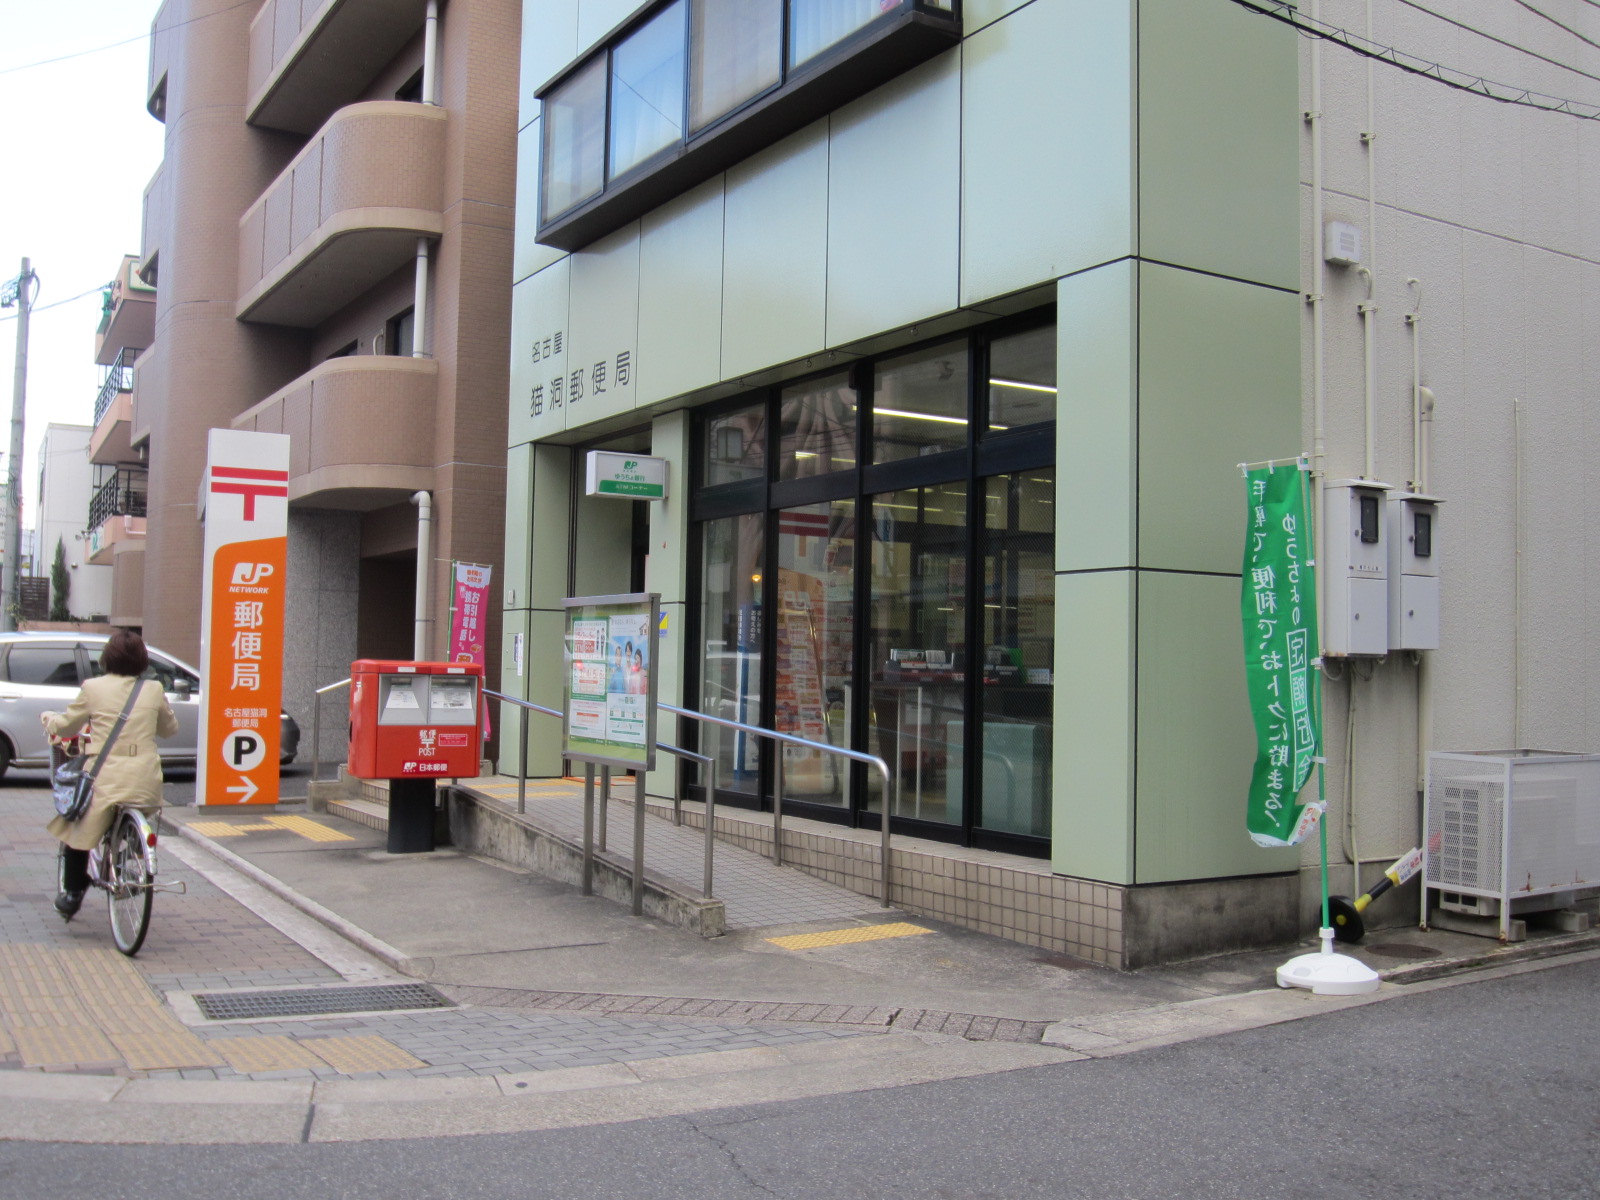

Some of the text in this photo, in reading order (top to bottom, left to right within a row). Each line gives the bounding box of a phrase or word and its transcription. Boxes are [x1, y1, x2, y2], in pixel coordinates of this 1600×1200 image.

[532, 331, 562, 363] 名古屋
[531, 350, 630, 418] 猫洞郵便局
[614, 473, 646, 482] ゆうちょ銀行
[229, 586, 269, 594] NETWORK
[468, 591, 481, 642] お引越し
[230, 600, 263, 691] 郵便局
[224, 707, 267, 718] 名古屋猫洞
[232, 718, 259, 729] 郵便局
[233, 736, 258, 765] P
[418, 747, 436, 757] POST
[419, 763, 448, 772] 日本郵便
